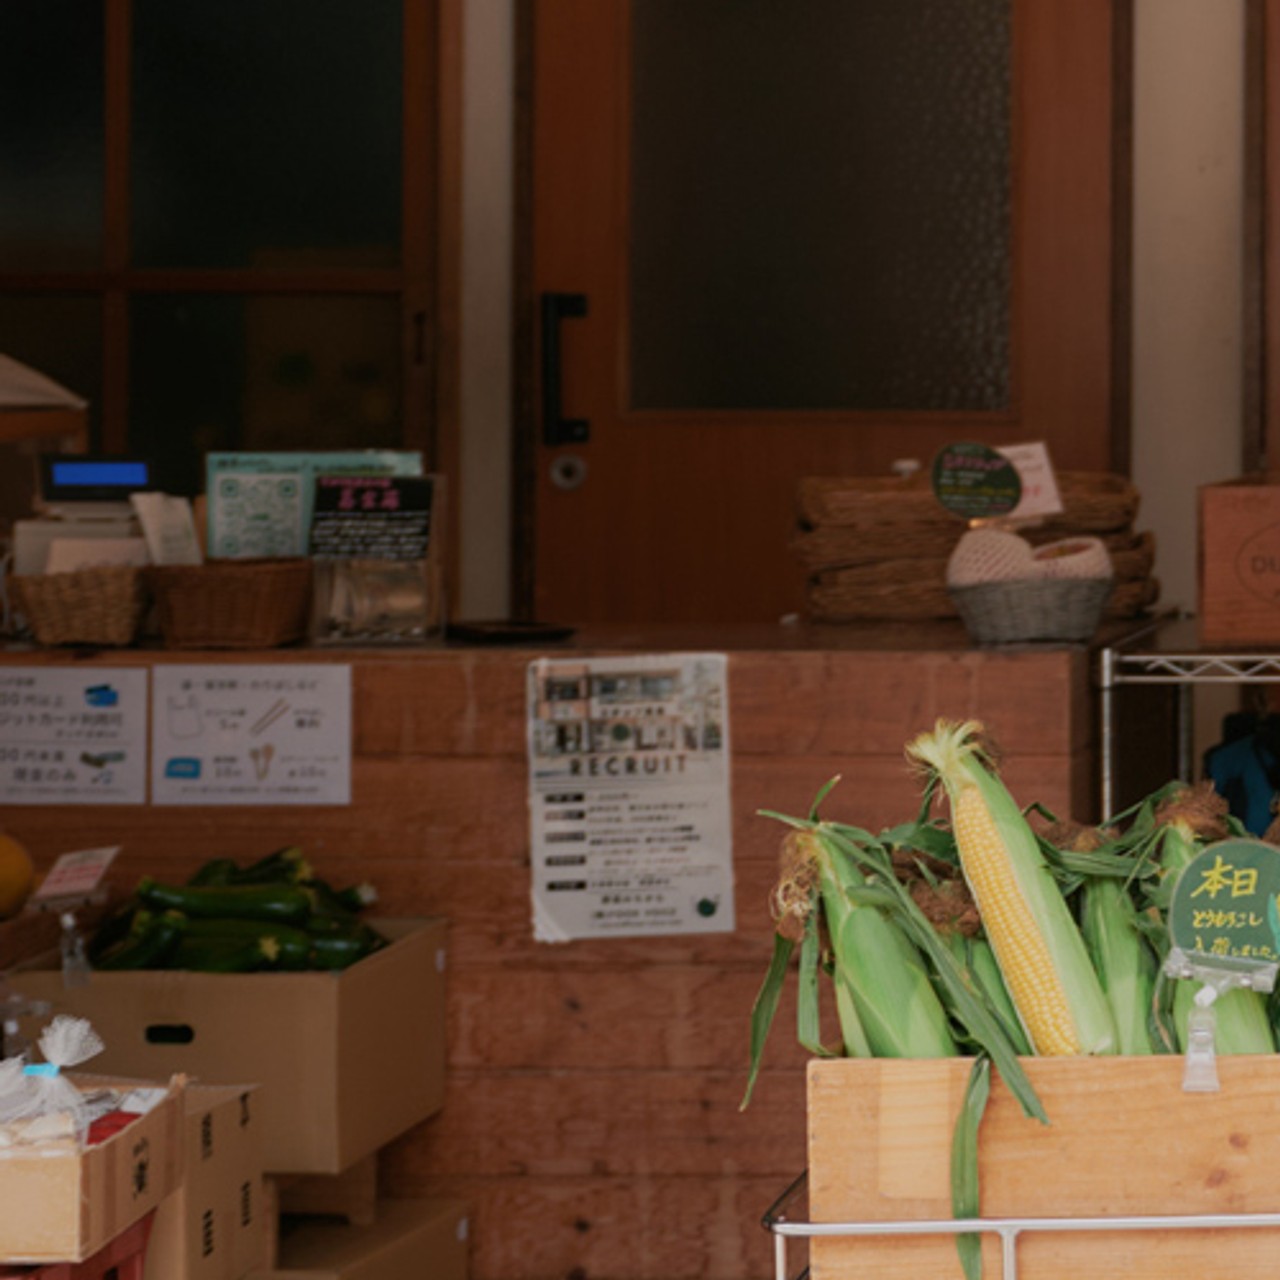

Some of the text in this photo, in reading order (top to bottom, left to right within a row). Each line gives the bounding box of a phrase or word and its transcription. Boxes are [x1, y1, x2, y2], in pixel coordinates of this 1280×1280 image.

[569, 755, 688, 778] RECRUIT
[1190, 854, 1259, 899] 本日
[1192, 908, 1263, 929] とうもろこし
